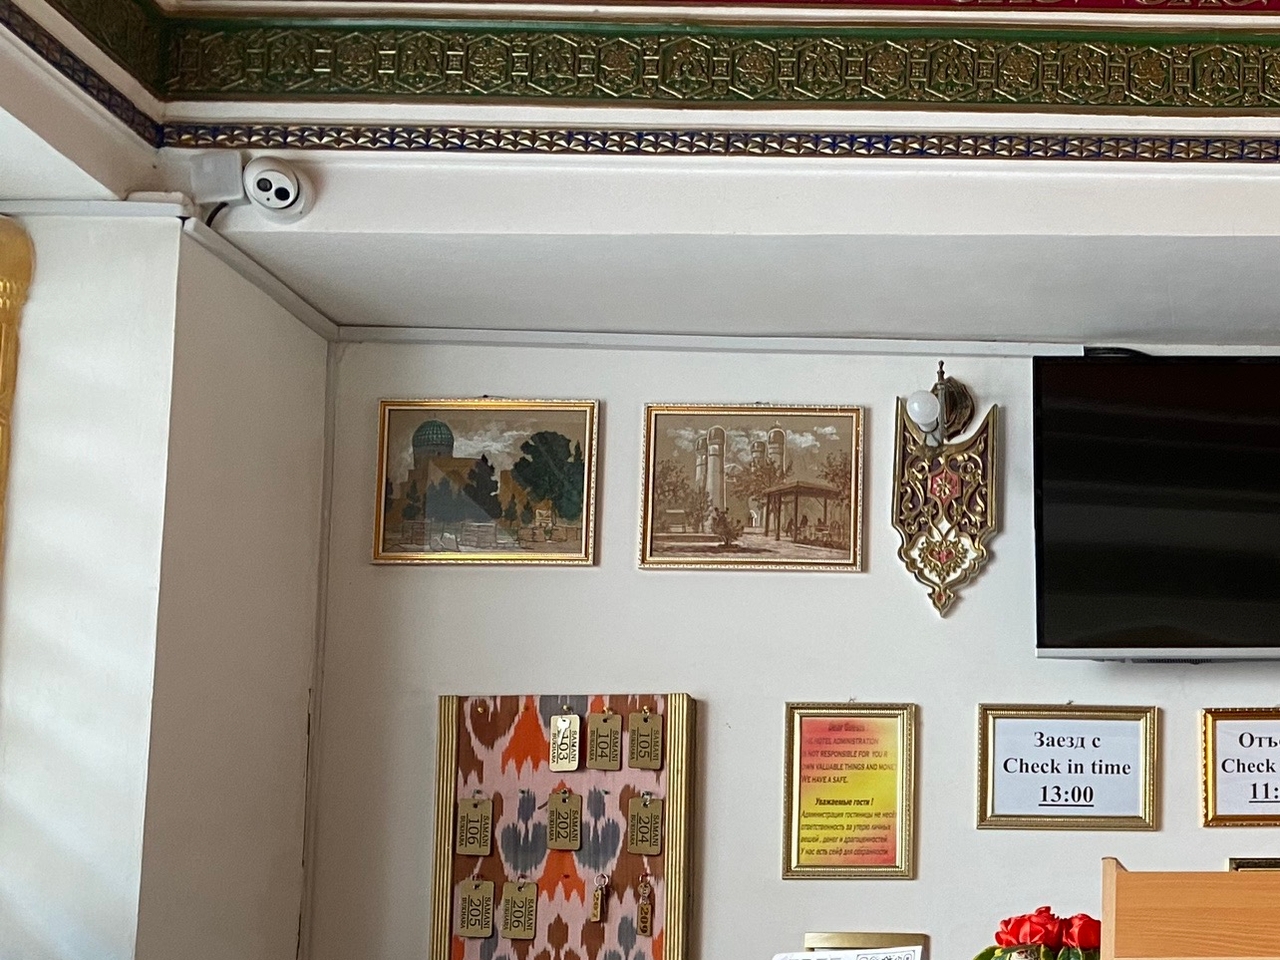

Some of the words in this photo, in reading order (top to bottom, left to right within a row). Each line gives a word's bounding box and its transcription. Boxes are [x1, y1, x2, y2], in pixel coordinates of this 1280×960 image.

[558, 734, 569, 761] 103
[598, 734, 610, 759] 104
[611, 730, 619, 762] SAMANI
[638, 733, 650, 758] 105
[1033, 731, 1086, 749] Заезд
[1092, 736, 1101, 748] с
[1003, 758, 1062, 774] Check
[1068, 759, 1084, 775] in
[1092, 759, 1132, 775] time
[1221, 758, 1276, 773] Check
[815, 798, 852, 806] Уважаемые
[1040, 786, 1094, 803] 13:00
[557, 812, 569, 839] 202
[571, 809, 579, 842] SAMANI
[802, 810, 844, 819] Администрация
[468, 818, 480, 846] 106
[481, 815, 490, 848] SAMANI
[638, 816, 650, 845] 204
[469, 899, 482, 927] 205
[483, 896, 492, 930] SAMANI
[511, 900, 524, 928] 206
[526, 898, 535, 932] SAMANI
[640, 906, 650, 934] 209
